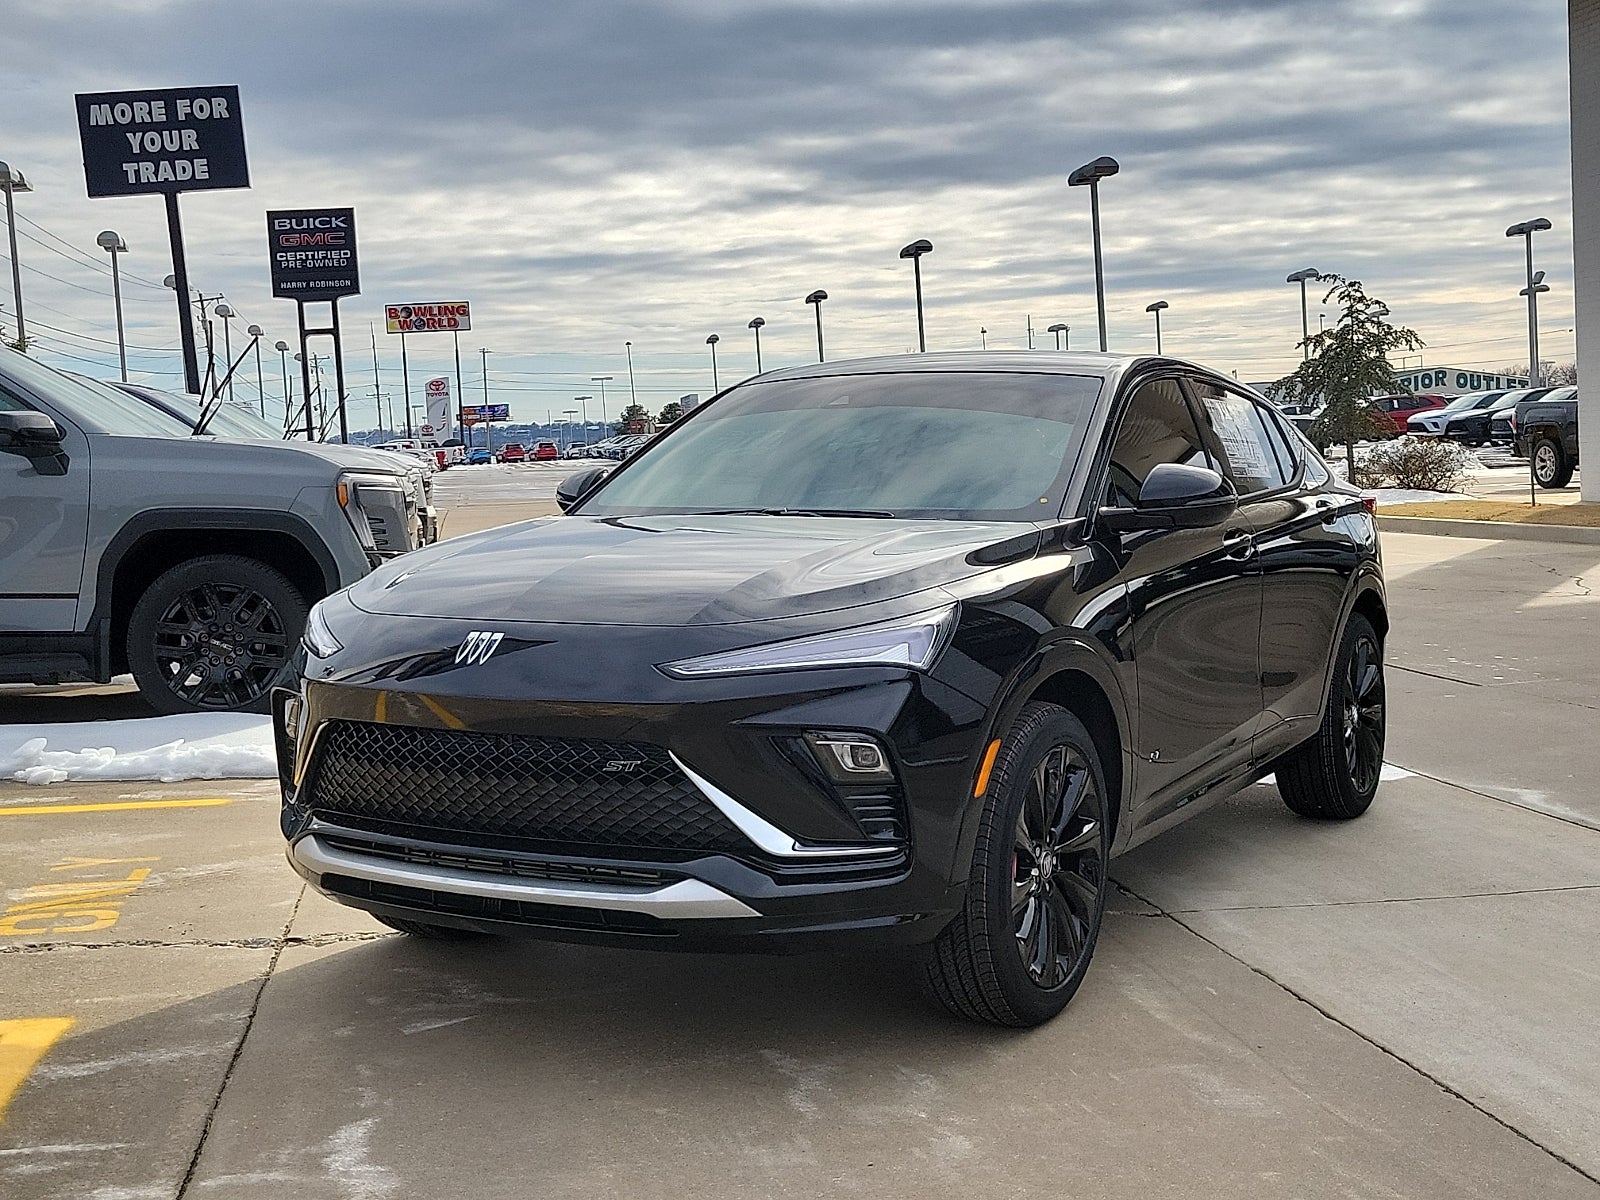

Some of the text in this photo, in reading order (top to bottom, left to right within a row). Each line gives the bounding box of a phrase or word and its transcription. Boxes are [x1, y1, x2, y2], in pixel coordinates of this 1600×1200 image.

[90, 97, 230, 126] MORE FOR
[126, 128, 200, 154] YOUR
[122, 158, 209, 184] TRADE
[274, 216, 348, 231] BUICK
[279, 232, 346, 247] GMC
[276, 250, 351, 261] CERTIFIED
[281, 259, 347, 269] PRE-OWNED
[280, 279, 351, 289] HARRY ROBINSON
[388, 305, 468, 319] BOWLING
[398, 317, 460, 331] WORLD
[1456, 372, 1530, 391] OUTLET
[602, 760, 642, 772] ST
